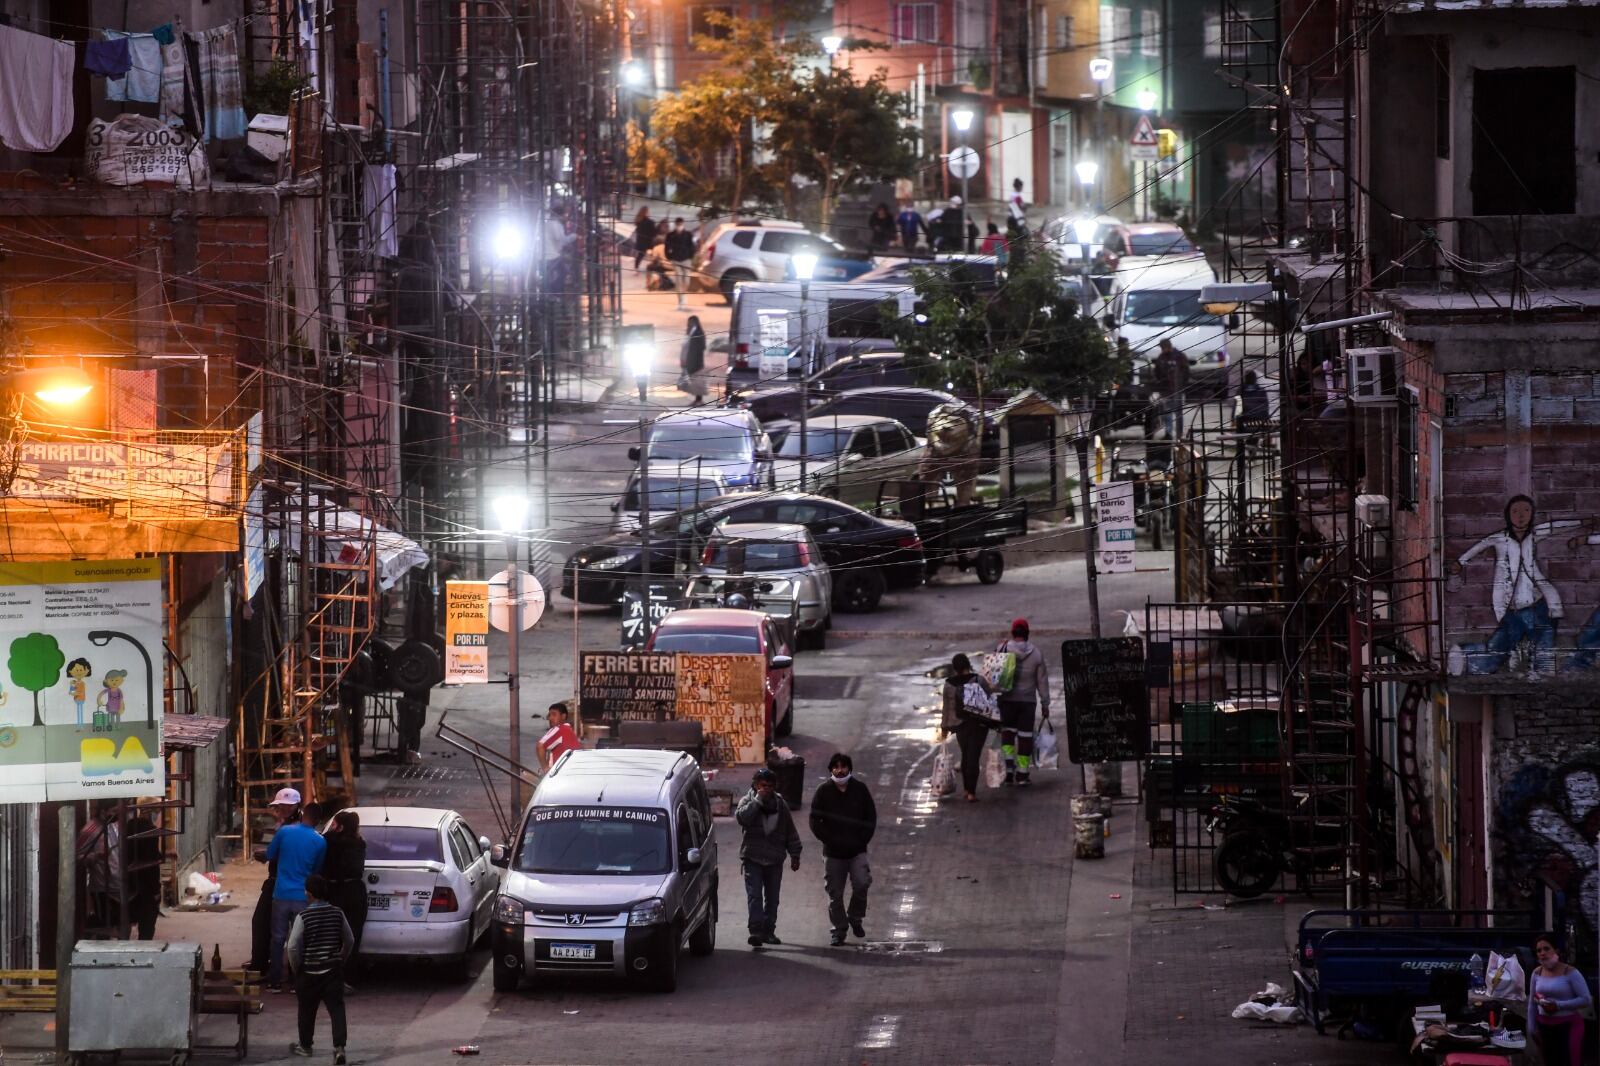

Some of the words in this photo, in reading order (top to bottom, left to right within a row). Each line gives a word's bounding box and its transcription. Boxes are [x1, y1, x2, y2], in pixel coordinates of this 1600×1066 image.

[126, 128, 185, 147] 2003
[1100, 499, 1125, 507] barrio
[1107, 530, 1121, 540] POR
[1121, 529, 1132, 539] FIN
[74, 567, 152, 577] buenosaires.gob.ar
[450, 592, 482, 601] Nuevas
[450, 601, 485, 610] canchas
[450, 611, 456, 619] y
[457, 610, 486, 619] plazas.
[456, 634, 471, 645] POR
[472, 634, 485, 645] FIN
[584, 655, 675, 674] FERRETERI
[635, 675, 676, 688] PINTUR
[635, 687, 676, 700] SANITARI
[702, 733, 752, 748] ACTEOS
[536, 812, 551, 821] QUE
[554, 810, 573, 818] DIOS
[576, 810, 610, 818] ILUMINE
[625, 811, 658, 822] CAMINO
